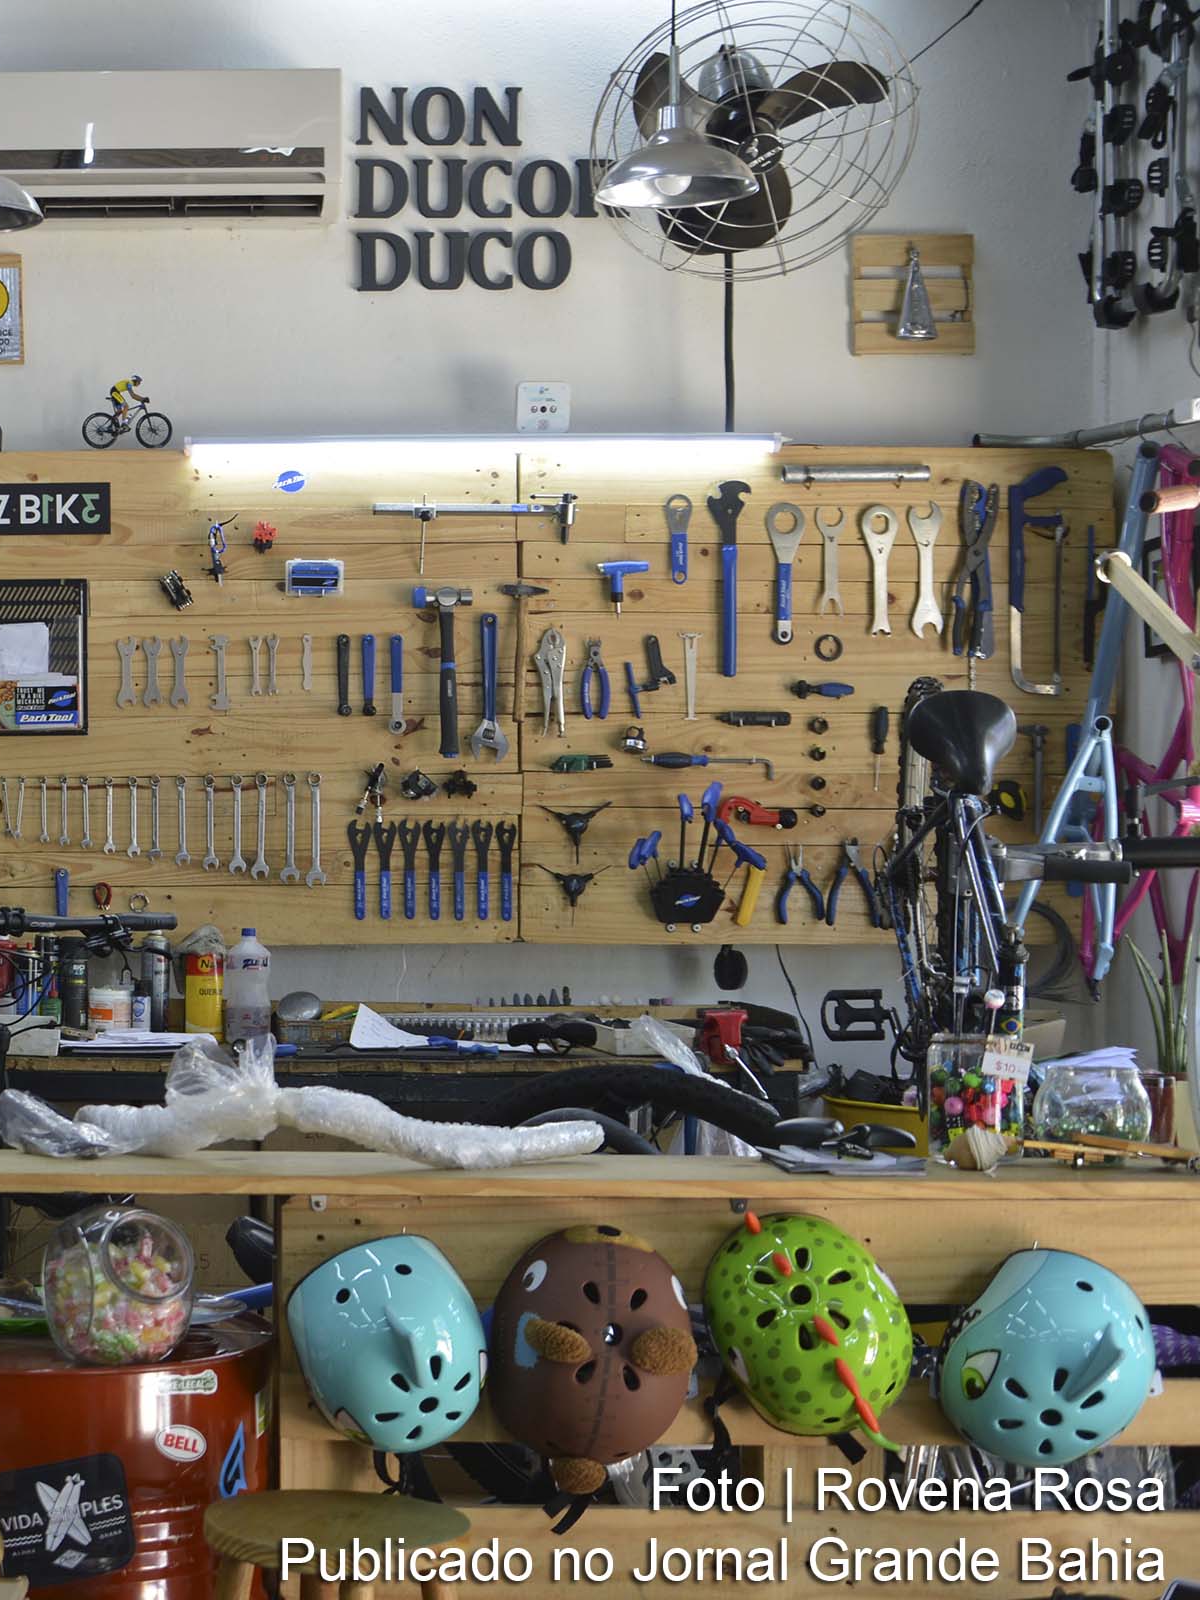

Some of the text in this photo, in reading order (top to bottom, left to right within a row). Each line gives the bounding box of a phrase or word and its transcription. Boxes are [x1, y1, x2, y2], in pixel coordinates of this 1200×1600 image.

[355, 86, 522, 146] NON
[356, 231, 572, 292] DUCO
[163, 1433, 199, 1454] BELL
[0, 1512, 44, 1532] VIDA
[80, 1494, 124, 1518] PLES
